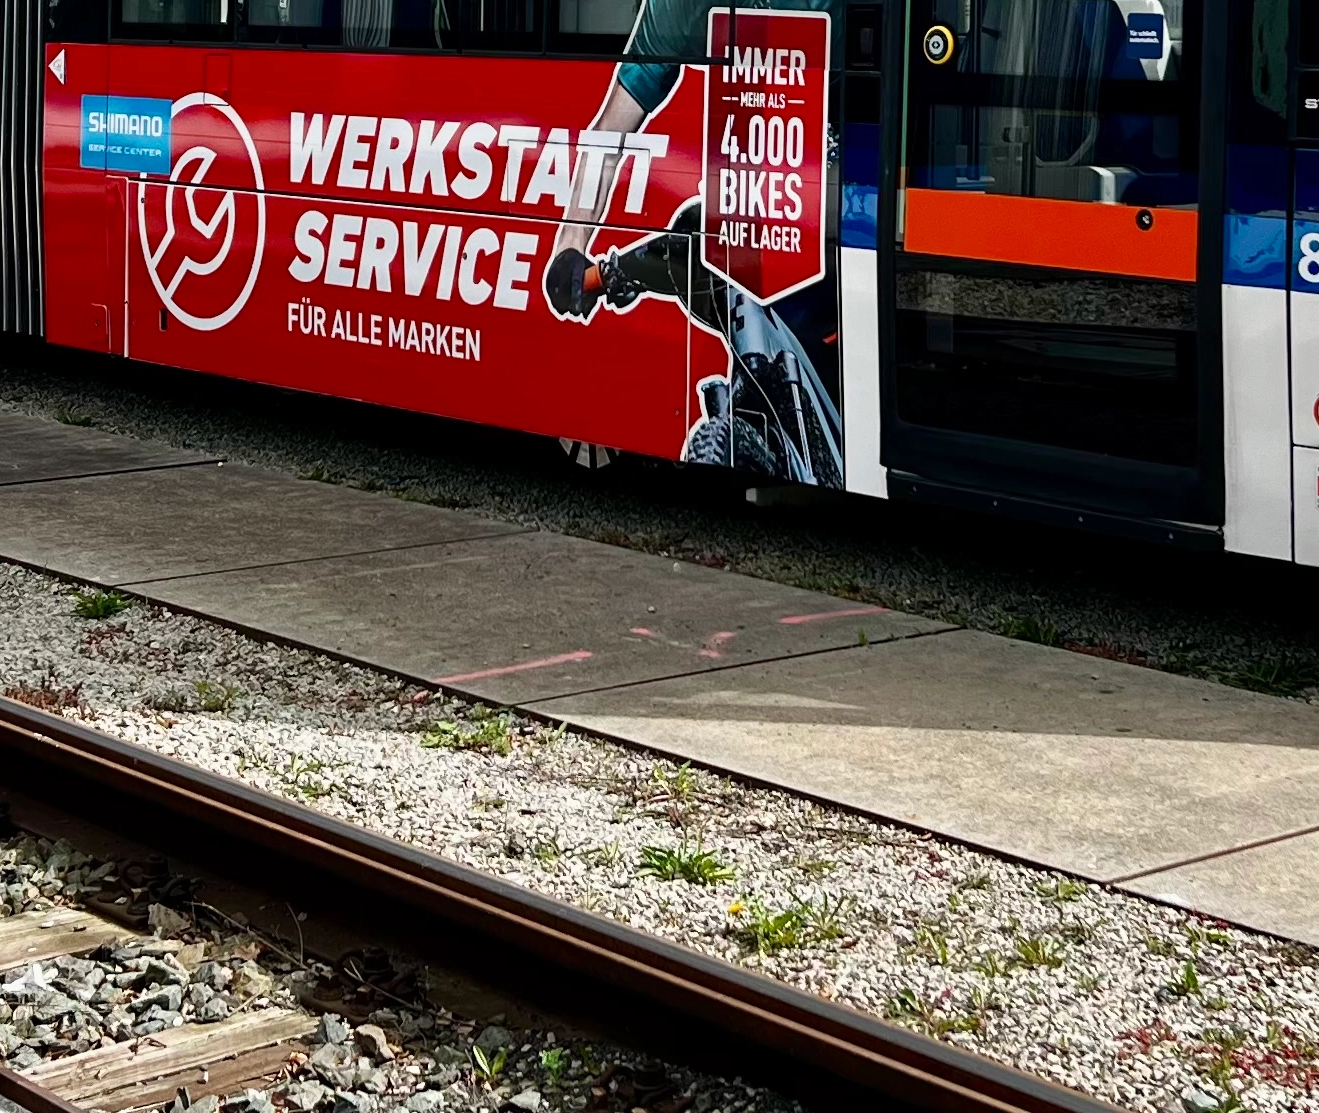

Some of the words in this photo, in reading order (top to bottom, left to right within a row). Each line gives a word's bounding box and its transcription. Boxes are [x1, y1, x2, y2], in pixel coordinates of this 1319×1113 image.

[722, 45, 806, 86] IMMER
[88, 111, 163, 137] SHIMANO
[740, 92, 765, 108] MEHR
[768, 93, 786, 109] ALS
[88, 143, 123, 154] SERVICE
[124, 146, 162, 157] CENTER
[289, 111, 670, 215] WERKSTATT
[720, 114, 804, 167] 4.000
[719, 168, 803, 221] BIKES
[288, 209, 539, 312] SERVICE
[718, 221, 748, 246] AUF
[750, 224, 802, 253] LAGER
[287, 296, 327, 338] FÜR
[331, 309, 383, 346] ALLE
[388, 318, 481, 362] MARKEN
